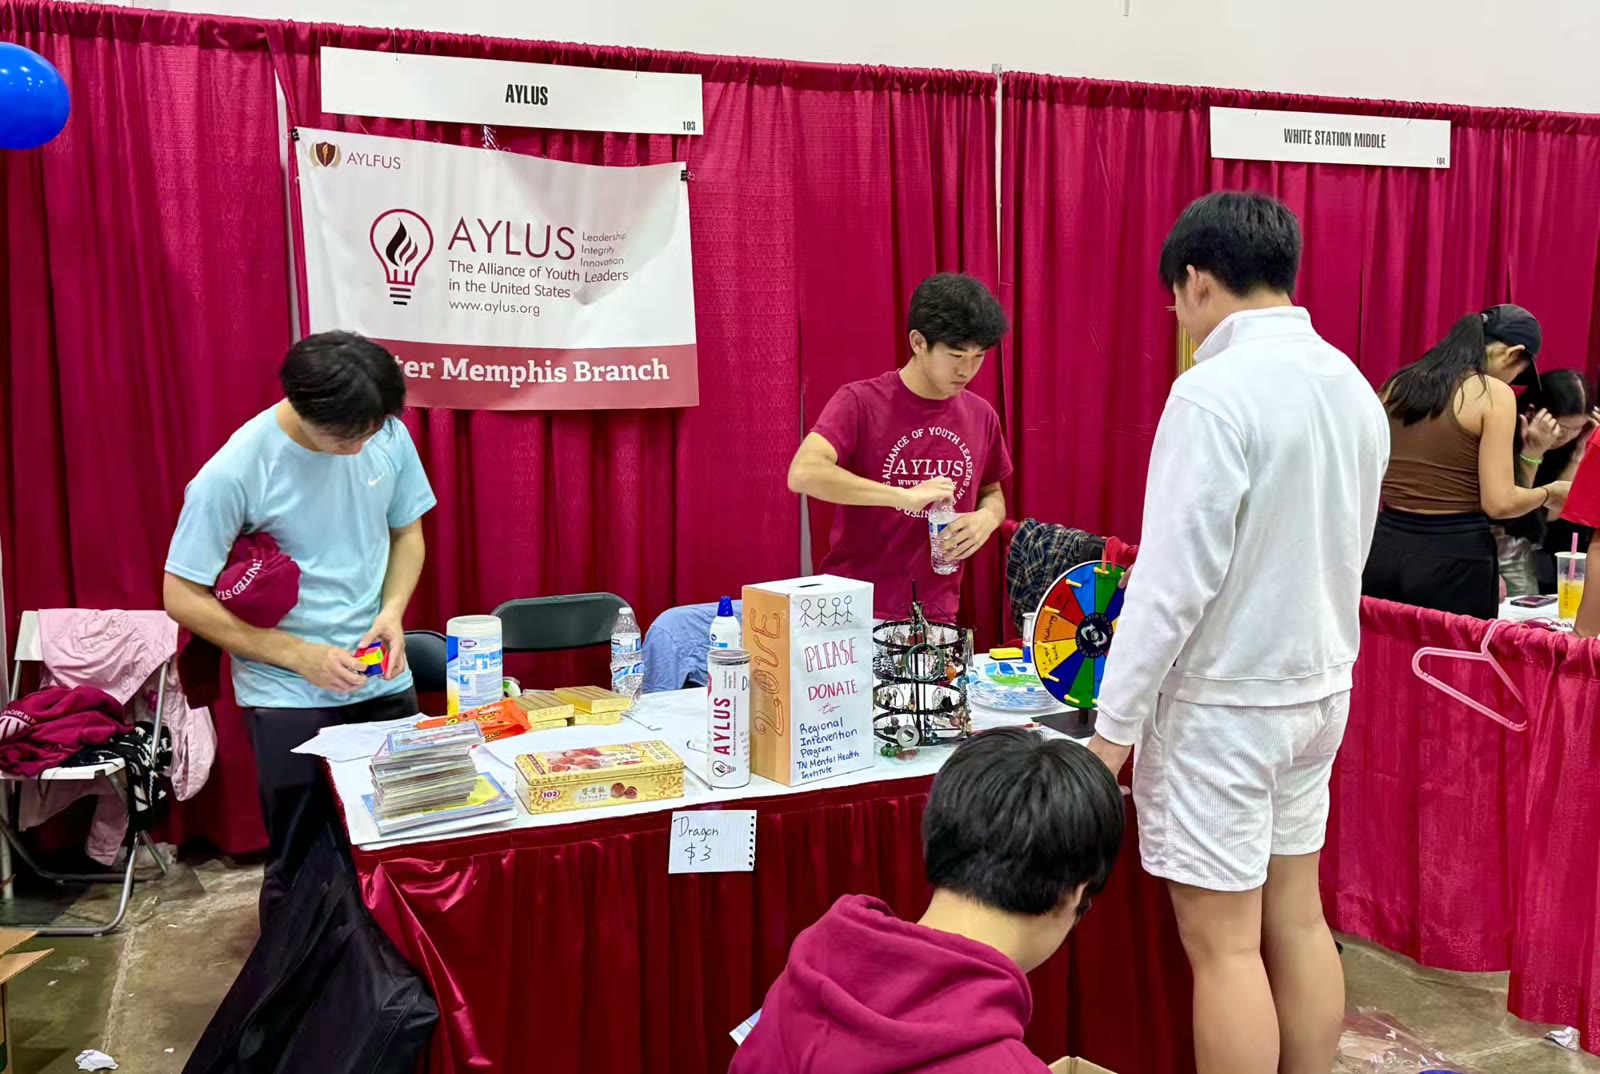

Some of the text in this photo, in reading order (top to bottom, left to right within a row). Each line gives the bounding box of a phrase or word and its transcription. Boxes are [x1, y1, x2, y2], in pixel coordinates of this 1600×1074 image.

[505, 84, 549, 106] AYLUS
[682, 121, 696, 131] 103
[1284, 128, 1386, 148] WHITE STATION MIDDLE
[346, 152, 401, 170] AYLFUS
[1436, 157, 1446, 166] 104
[448, 216, 575, 260] AYLUS
[582, 231, 627, 242] Leadership
[581, 244, 615, 256] Integrity
[449, 260, 629, 283] The Alliance of Youth Leaders
[580, 257, 624, 267] Innovation
[449, 278, 570, 298] in the United States
[449, 300, 540, 317] www.aylus.org
[440, 357, 568, 388] Memphis
[573, 358, 670, 382] Branch
[911, 428, 924, 439] OF
[928, 426, 960, 445] YOUTH
[882, 436, 910, 480] ALLIANCE
[892, 458, 964, 477] AYLUS
[958, 442, 972, 487] LEADERS
[956, 488, 965, 499] IN
[804, 637, 858, 672] PLEASE
[808, 679, 858, 701] DONATE
[818, 702, 840, 714] to
[714, 697, 731, 756] AYLUS
[800, 716, 844, 736] Regional
[800, 728, 857, 746] Intervention
[796, 750, 860, 770] TN Mental Health
[673, 816, 719, 842] Dragon
